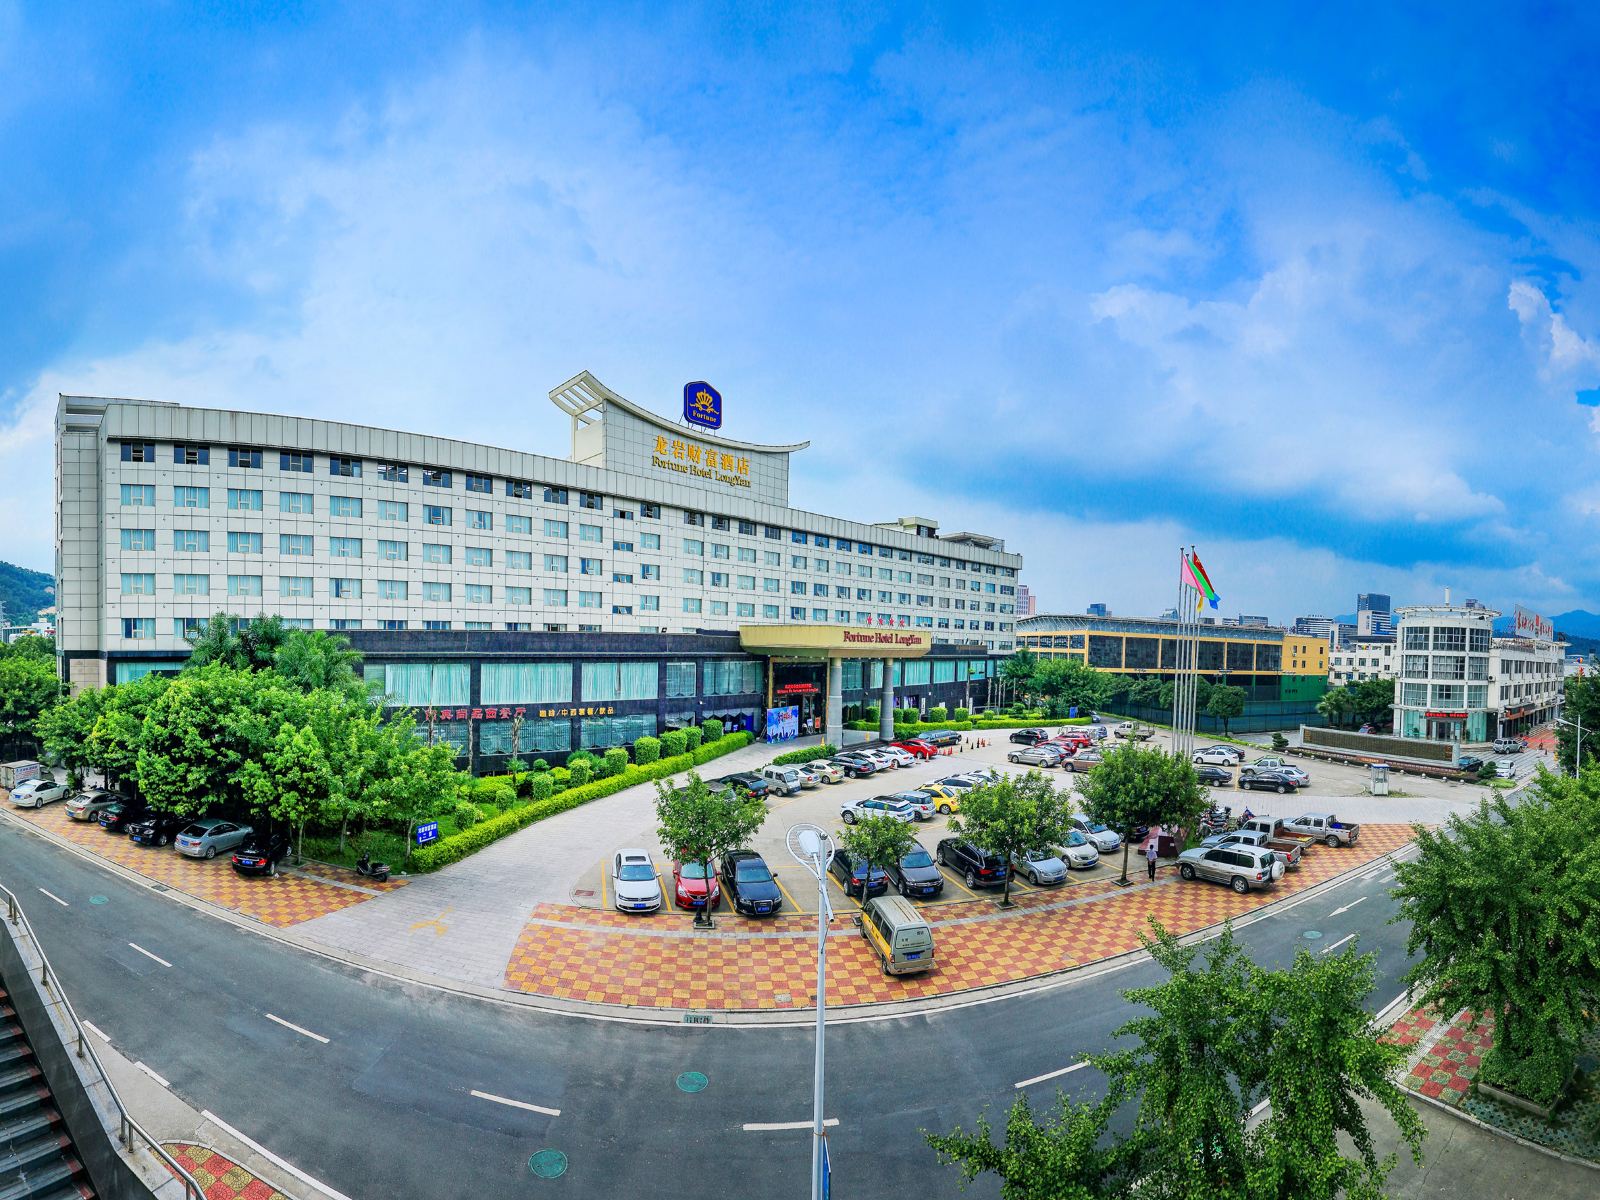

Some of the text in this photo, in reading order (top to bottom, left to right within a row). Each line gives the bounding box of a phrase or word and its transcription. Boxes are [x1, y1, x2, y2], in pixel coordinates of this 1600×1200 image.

[692, 411, 716, 422] Fortune
[654, 435, 750, 475] 龙岩财富酒店
[652, 456, 688, 474] Fortune
[689, 464, 713, 480] Hotel
[843, 631, 875, 643] Fortune
[875, 632, 893, 644] Hotel
